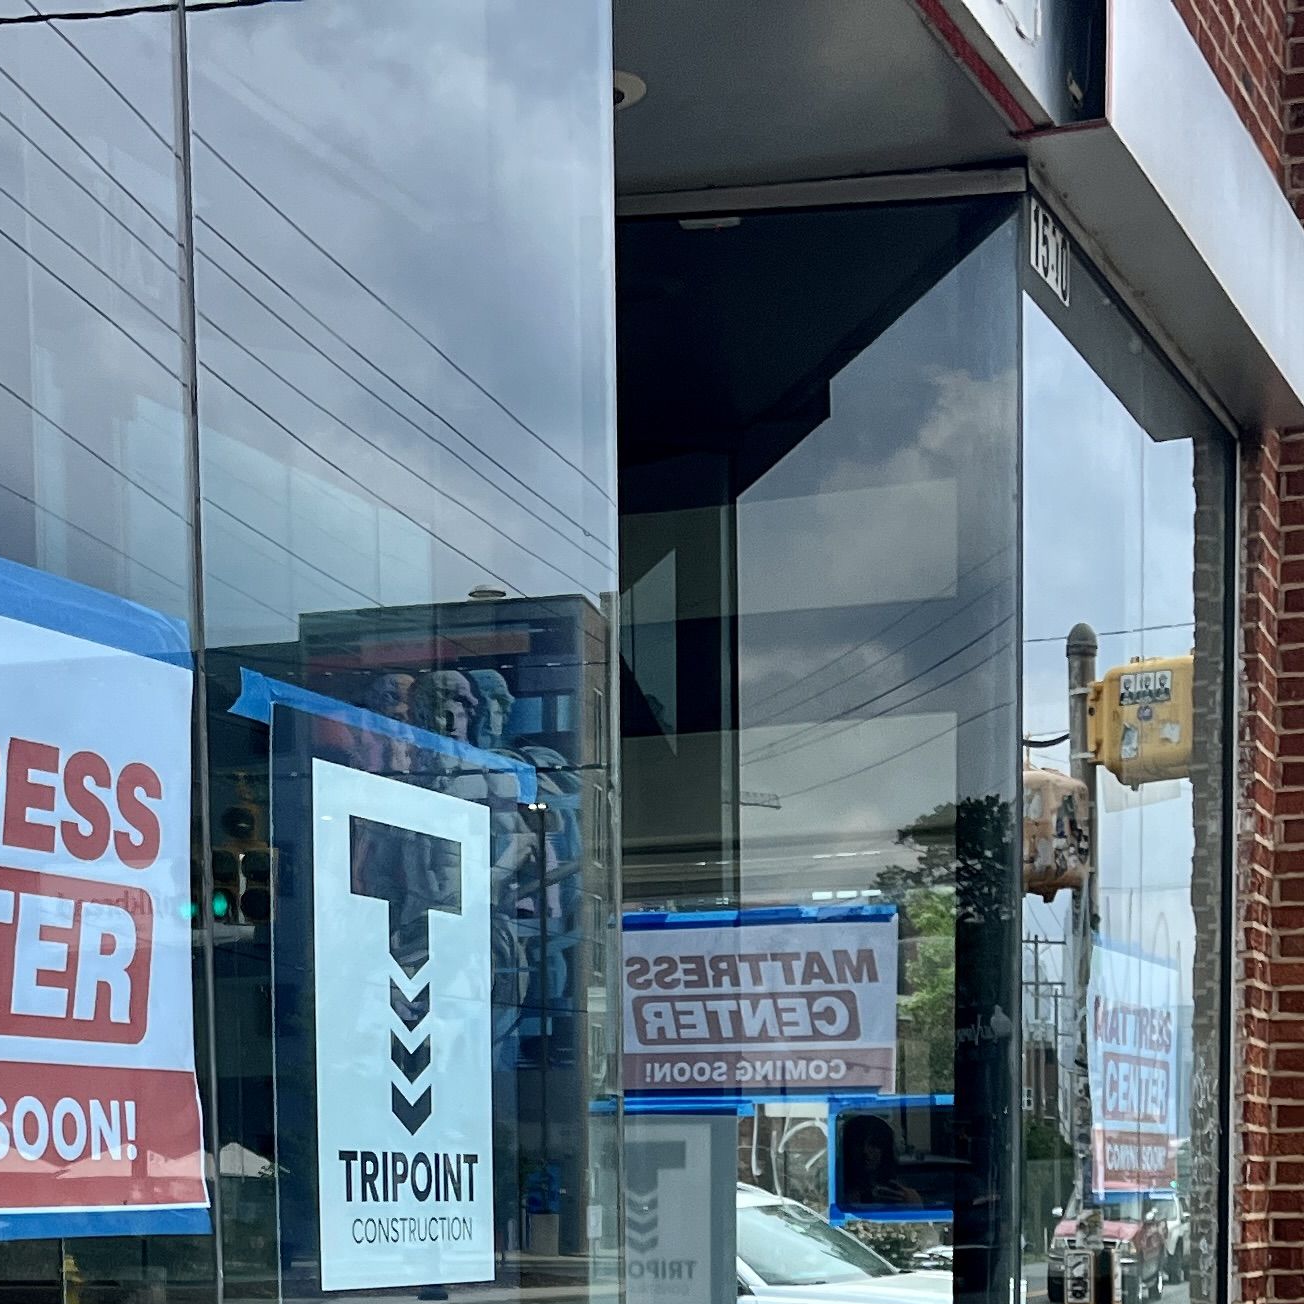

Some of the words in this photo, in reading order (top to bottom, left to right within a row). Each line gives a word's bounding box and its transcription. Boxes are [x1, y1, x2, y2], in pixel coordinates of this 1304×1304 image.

[1034, 205, 1067, 302] 1510
[338, 1148, 479, 1205] TRIPOINT
[351, 1214, 474, 1246] CONSTRUCTION
